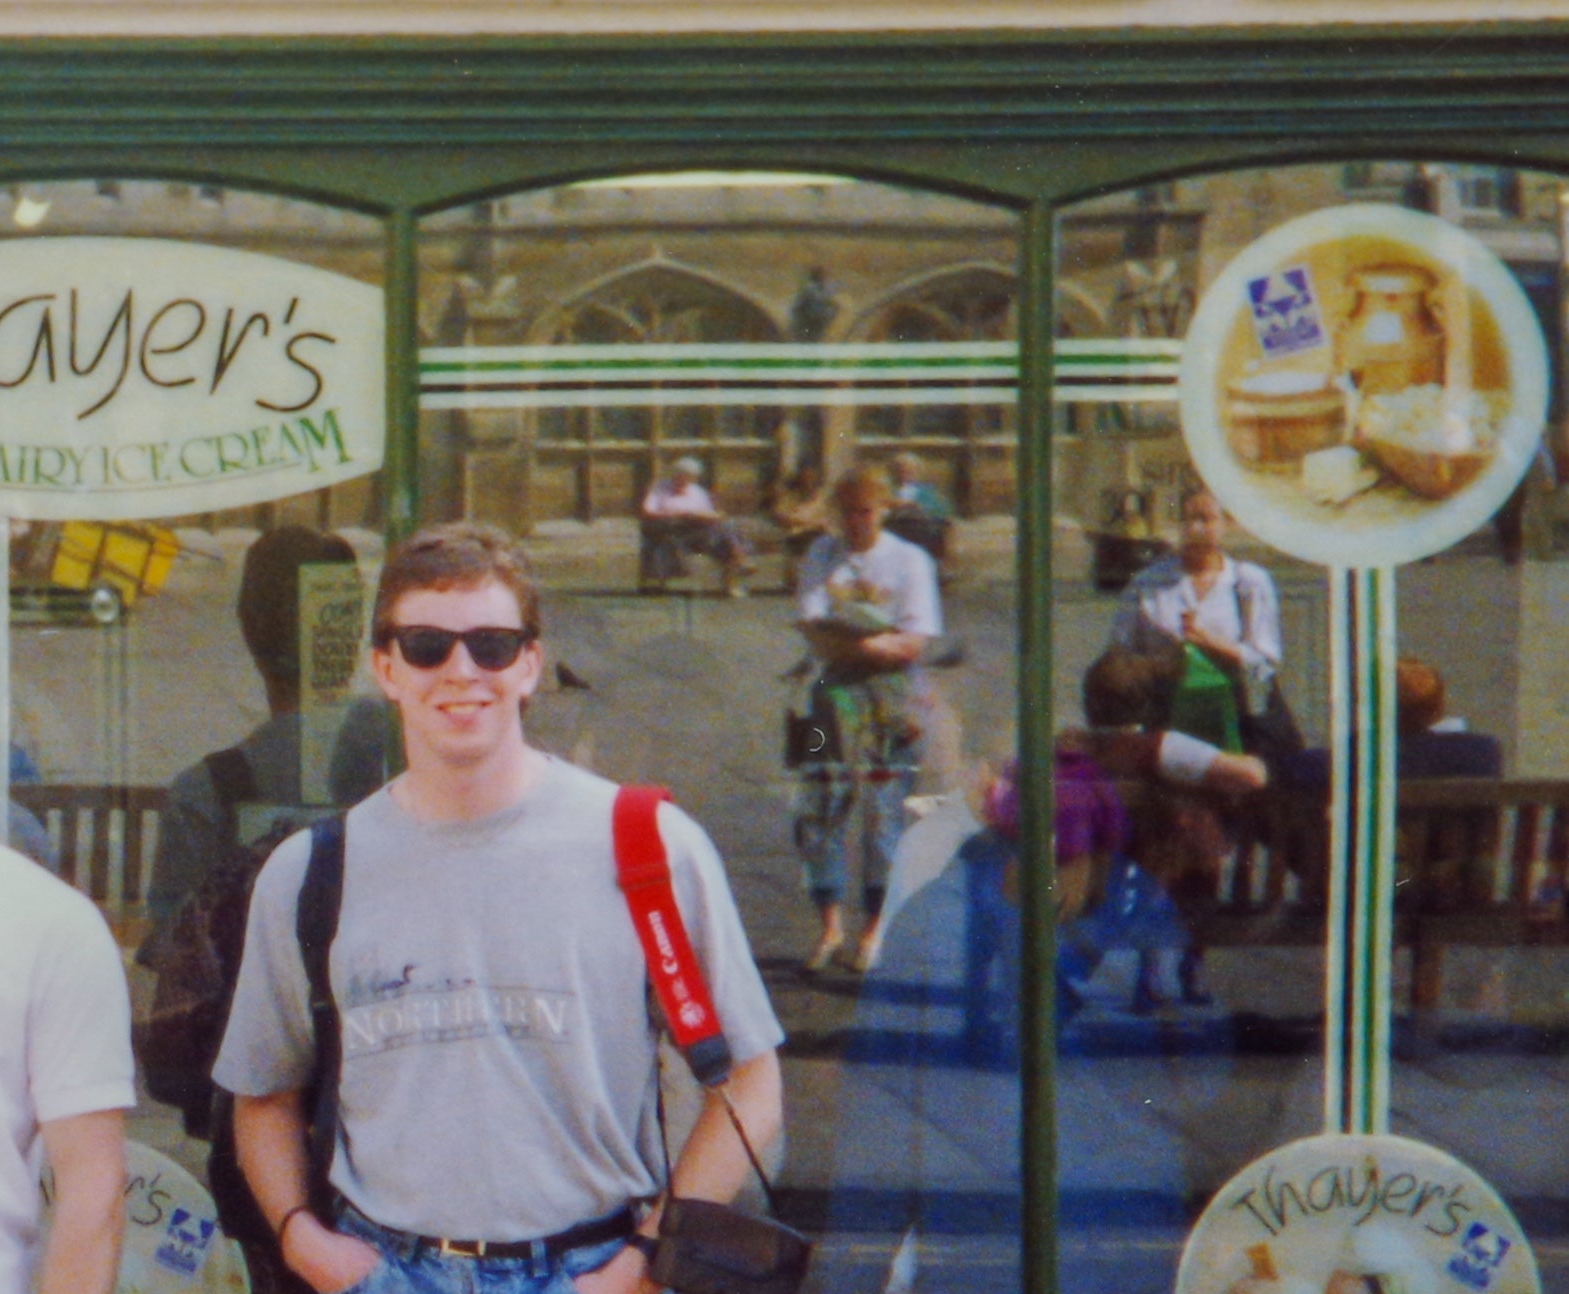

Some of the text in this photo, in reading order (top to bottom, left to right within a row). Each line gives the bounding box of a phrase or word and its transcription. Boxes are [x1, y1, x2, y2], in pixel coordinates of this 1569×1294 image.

[101, 441, 172, 486] ICE
[180, 406, 353, 479] CREAM
[1228, 1164, 1471, 1237] Thayer's
